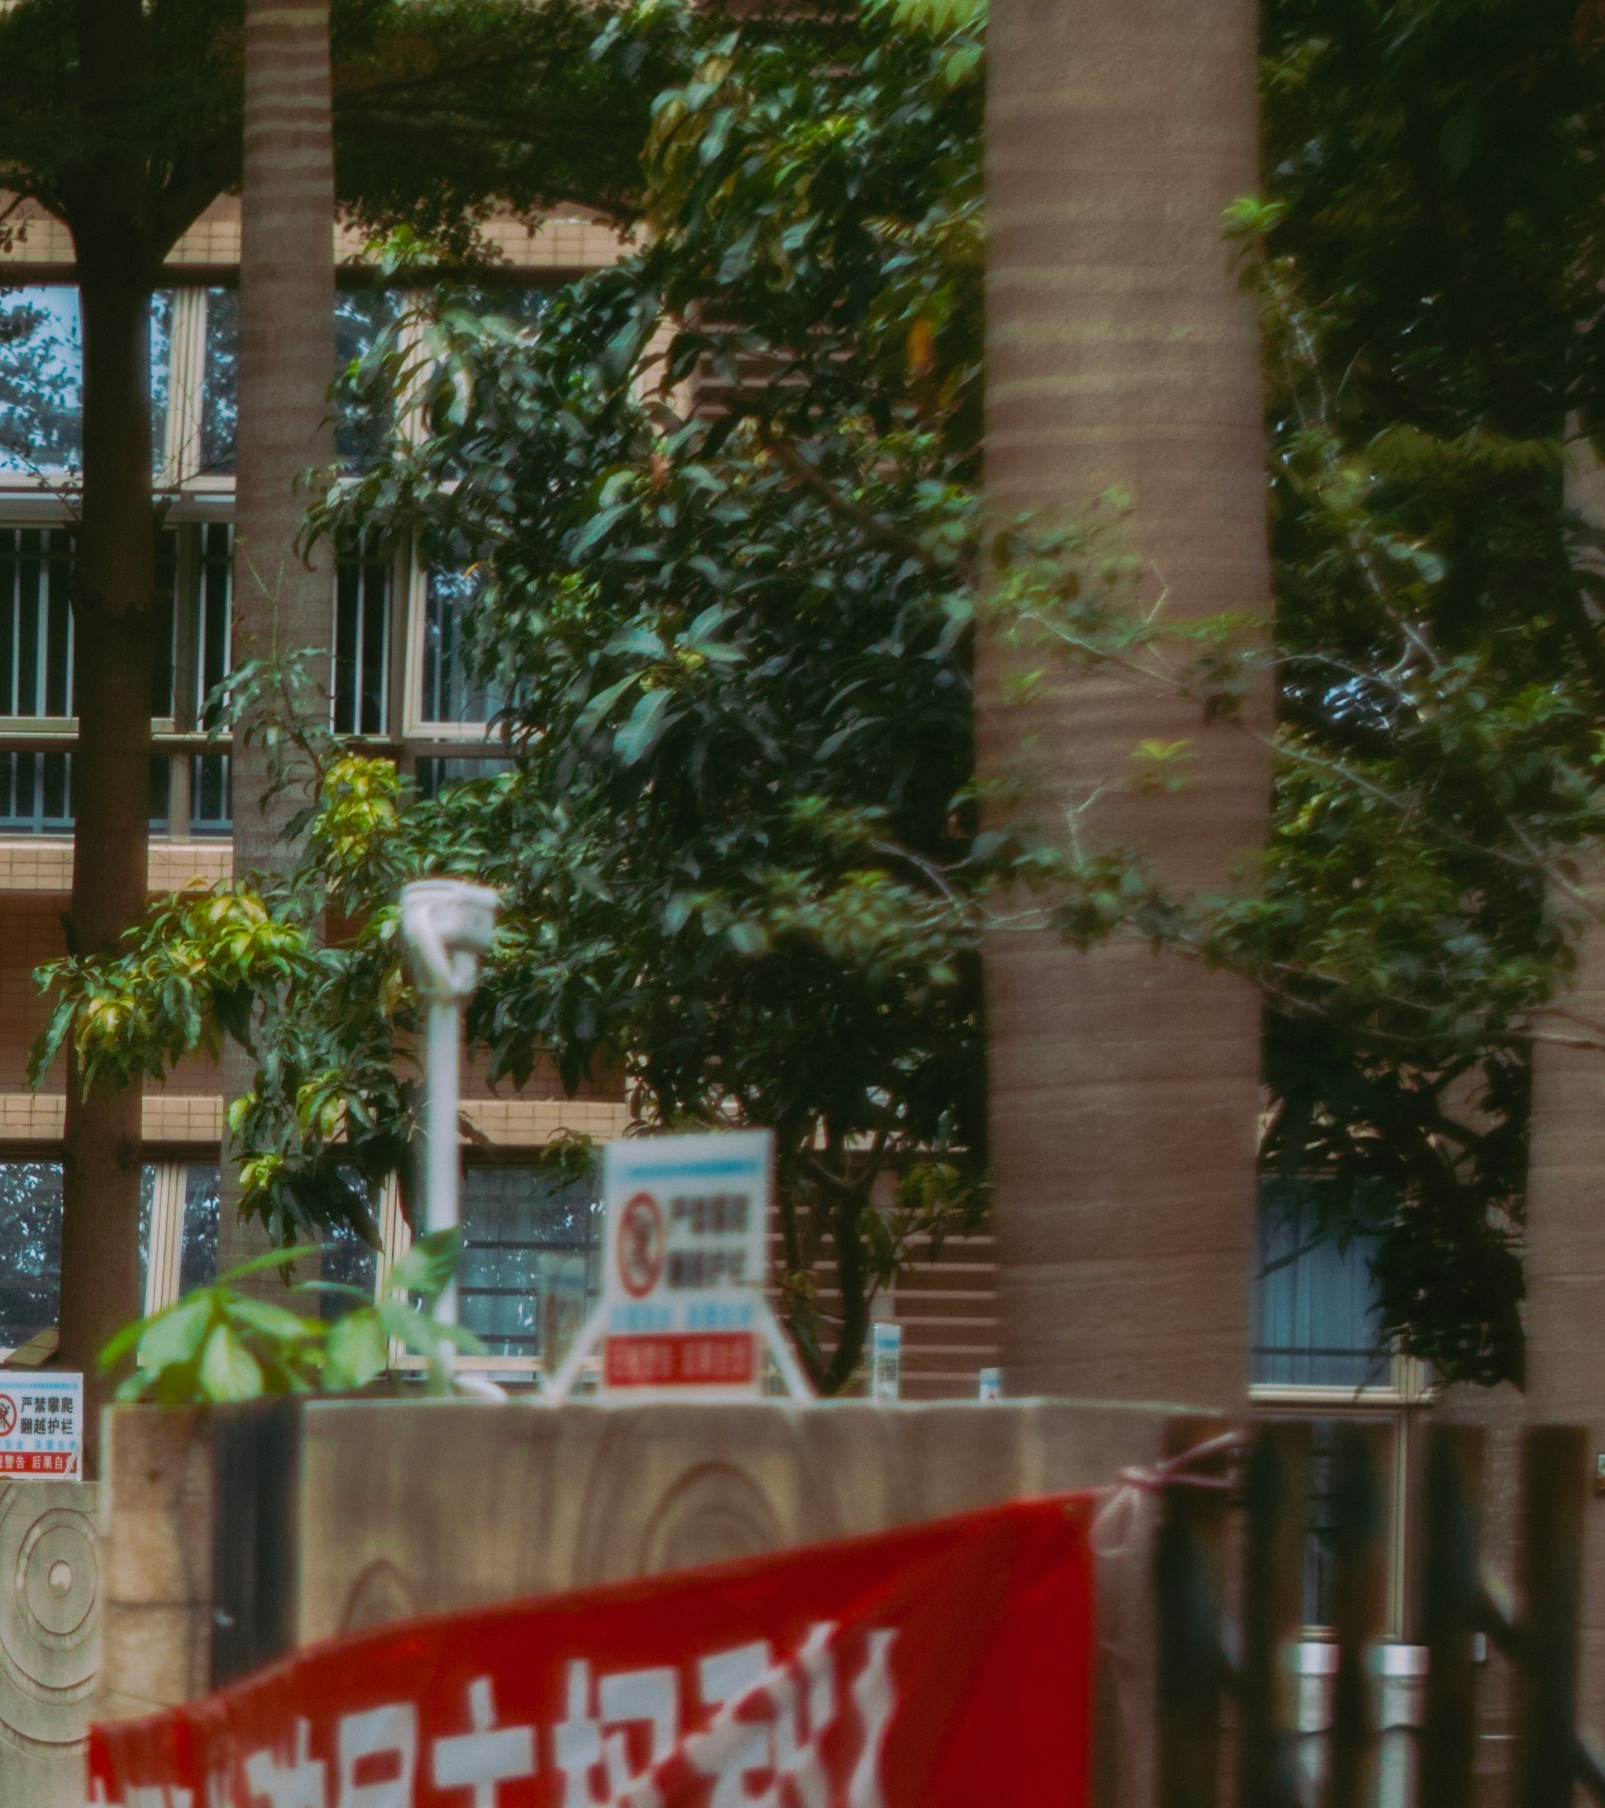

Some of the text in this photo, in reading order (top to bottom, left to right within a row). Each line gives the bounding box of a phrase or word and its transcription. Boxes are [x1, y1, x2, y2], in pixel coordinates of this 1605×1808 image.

[20, 1396, 74, 1414] 严禁攀爬
[20, 1417, 74, 1435] 翻越护栏
